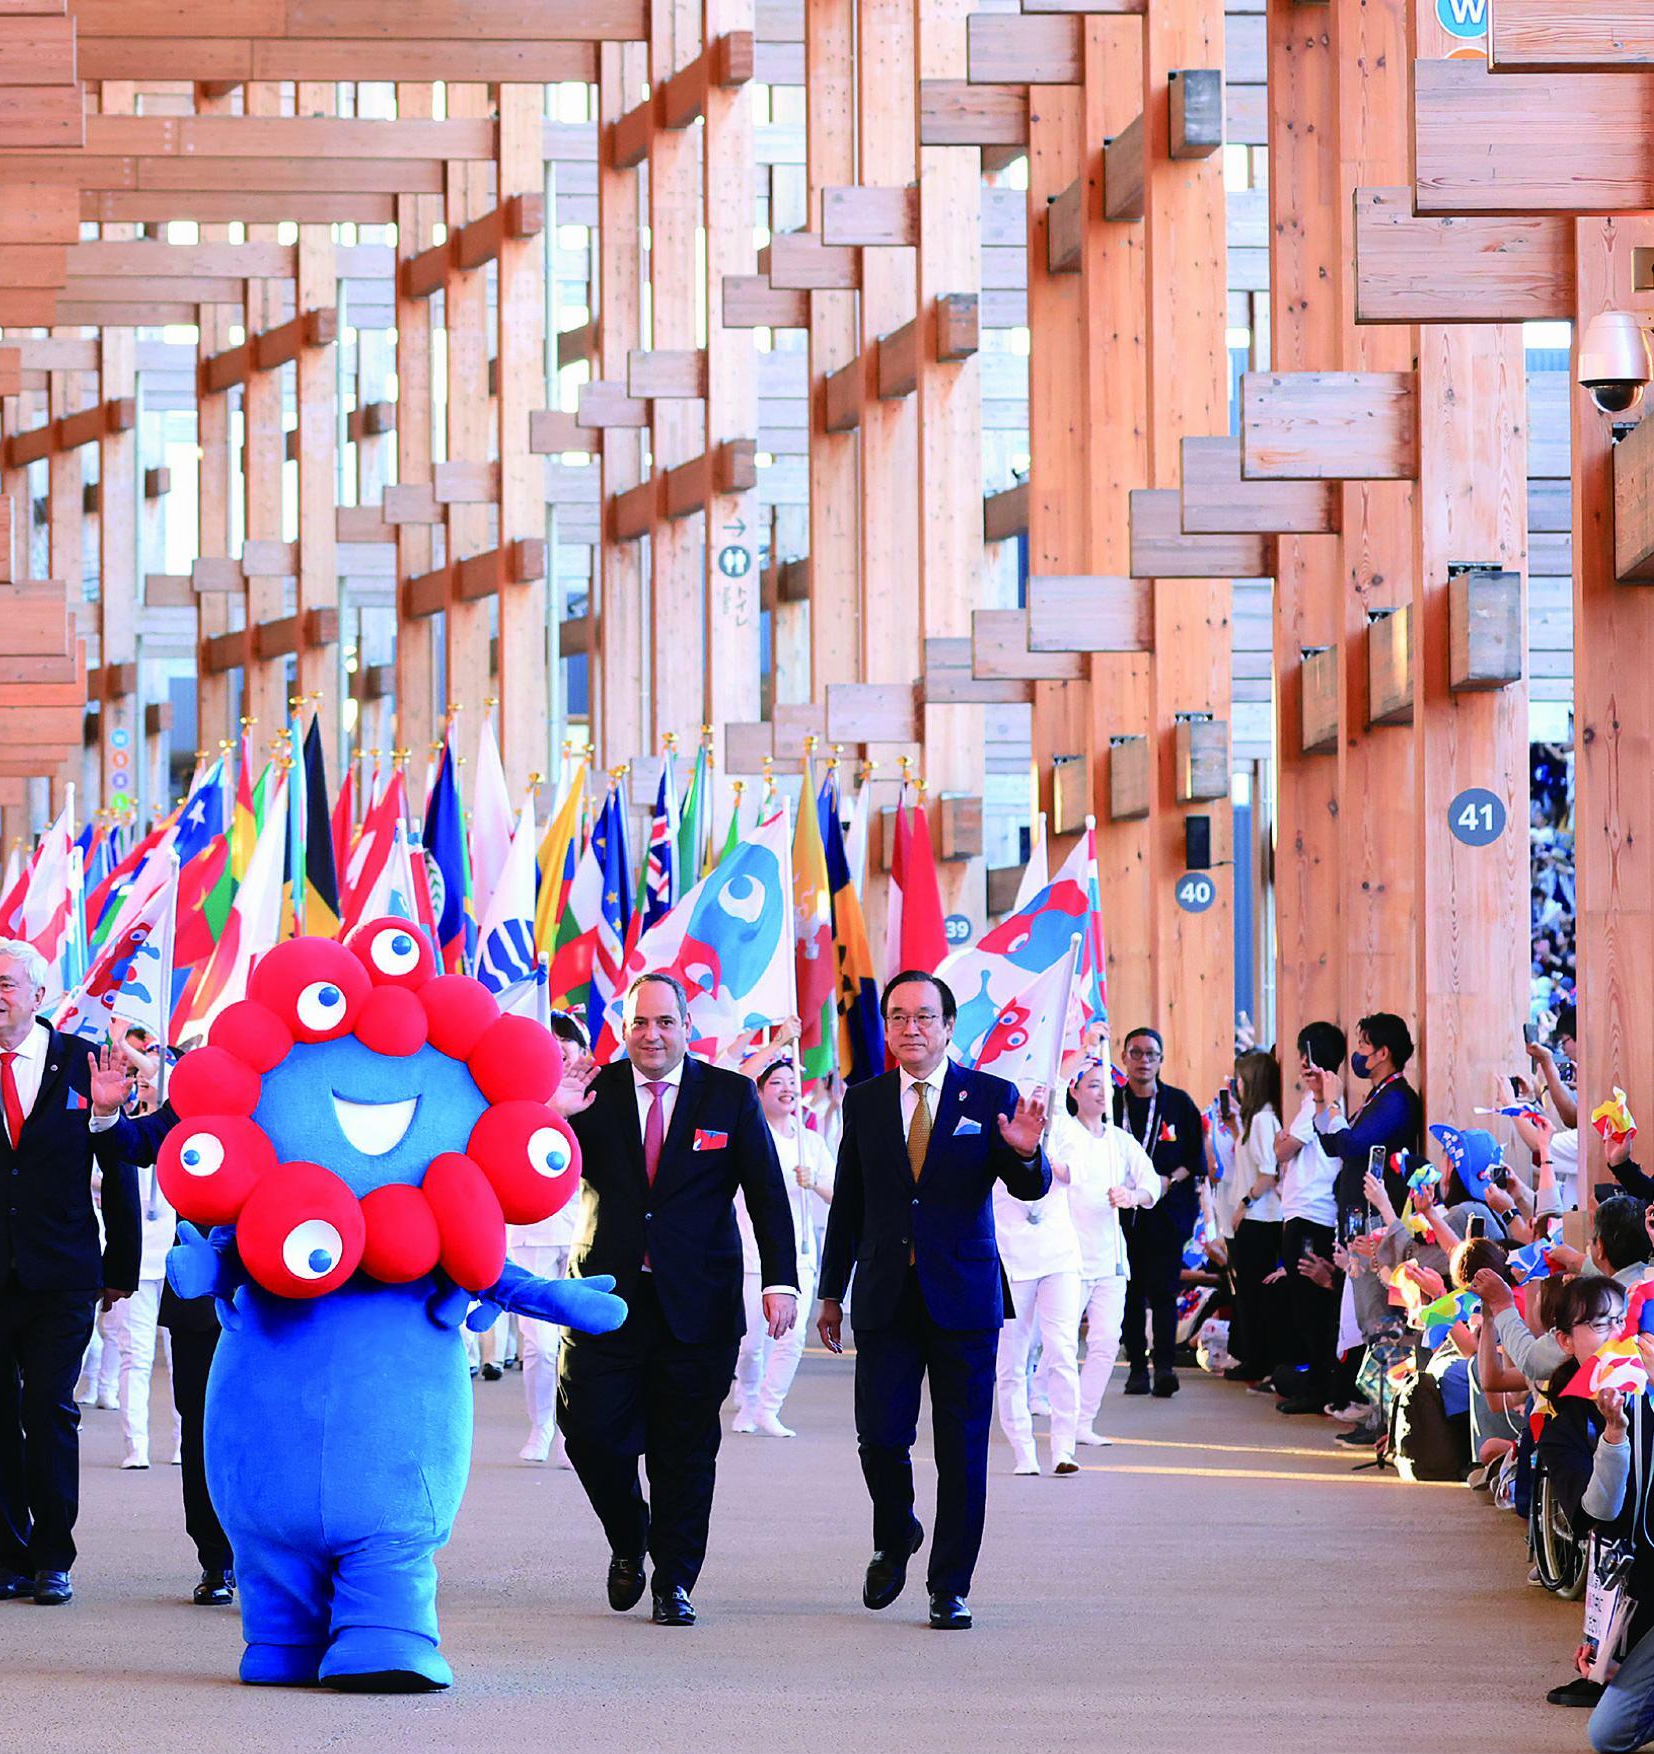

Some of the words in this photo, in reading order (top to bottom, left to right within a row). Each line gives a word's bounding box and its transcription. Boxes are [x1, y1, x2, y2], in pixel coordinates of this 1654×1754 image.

[1458, 803, 1492, 830] 41
[1180, 882, 1210, 903] 40
[945, 920, 969, 938] 39
